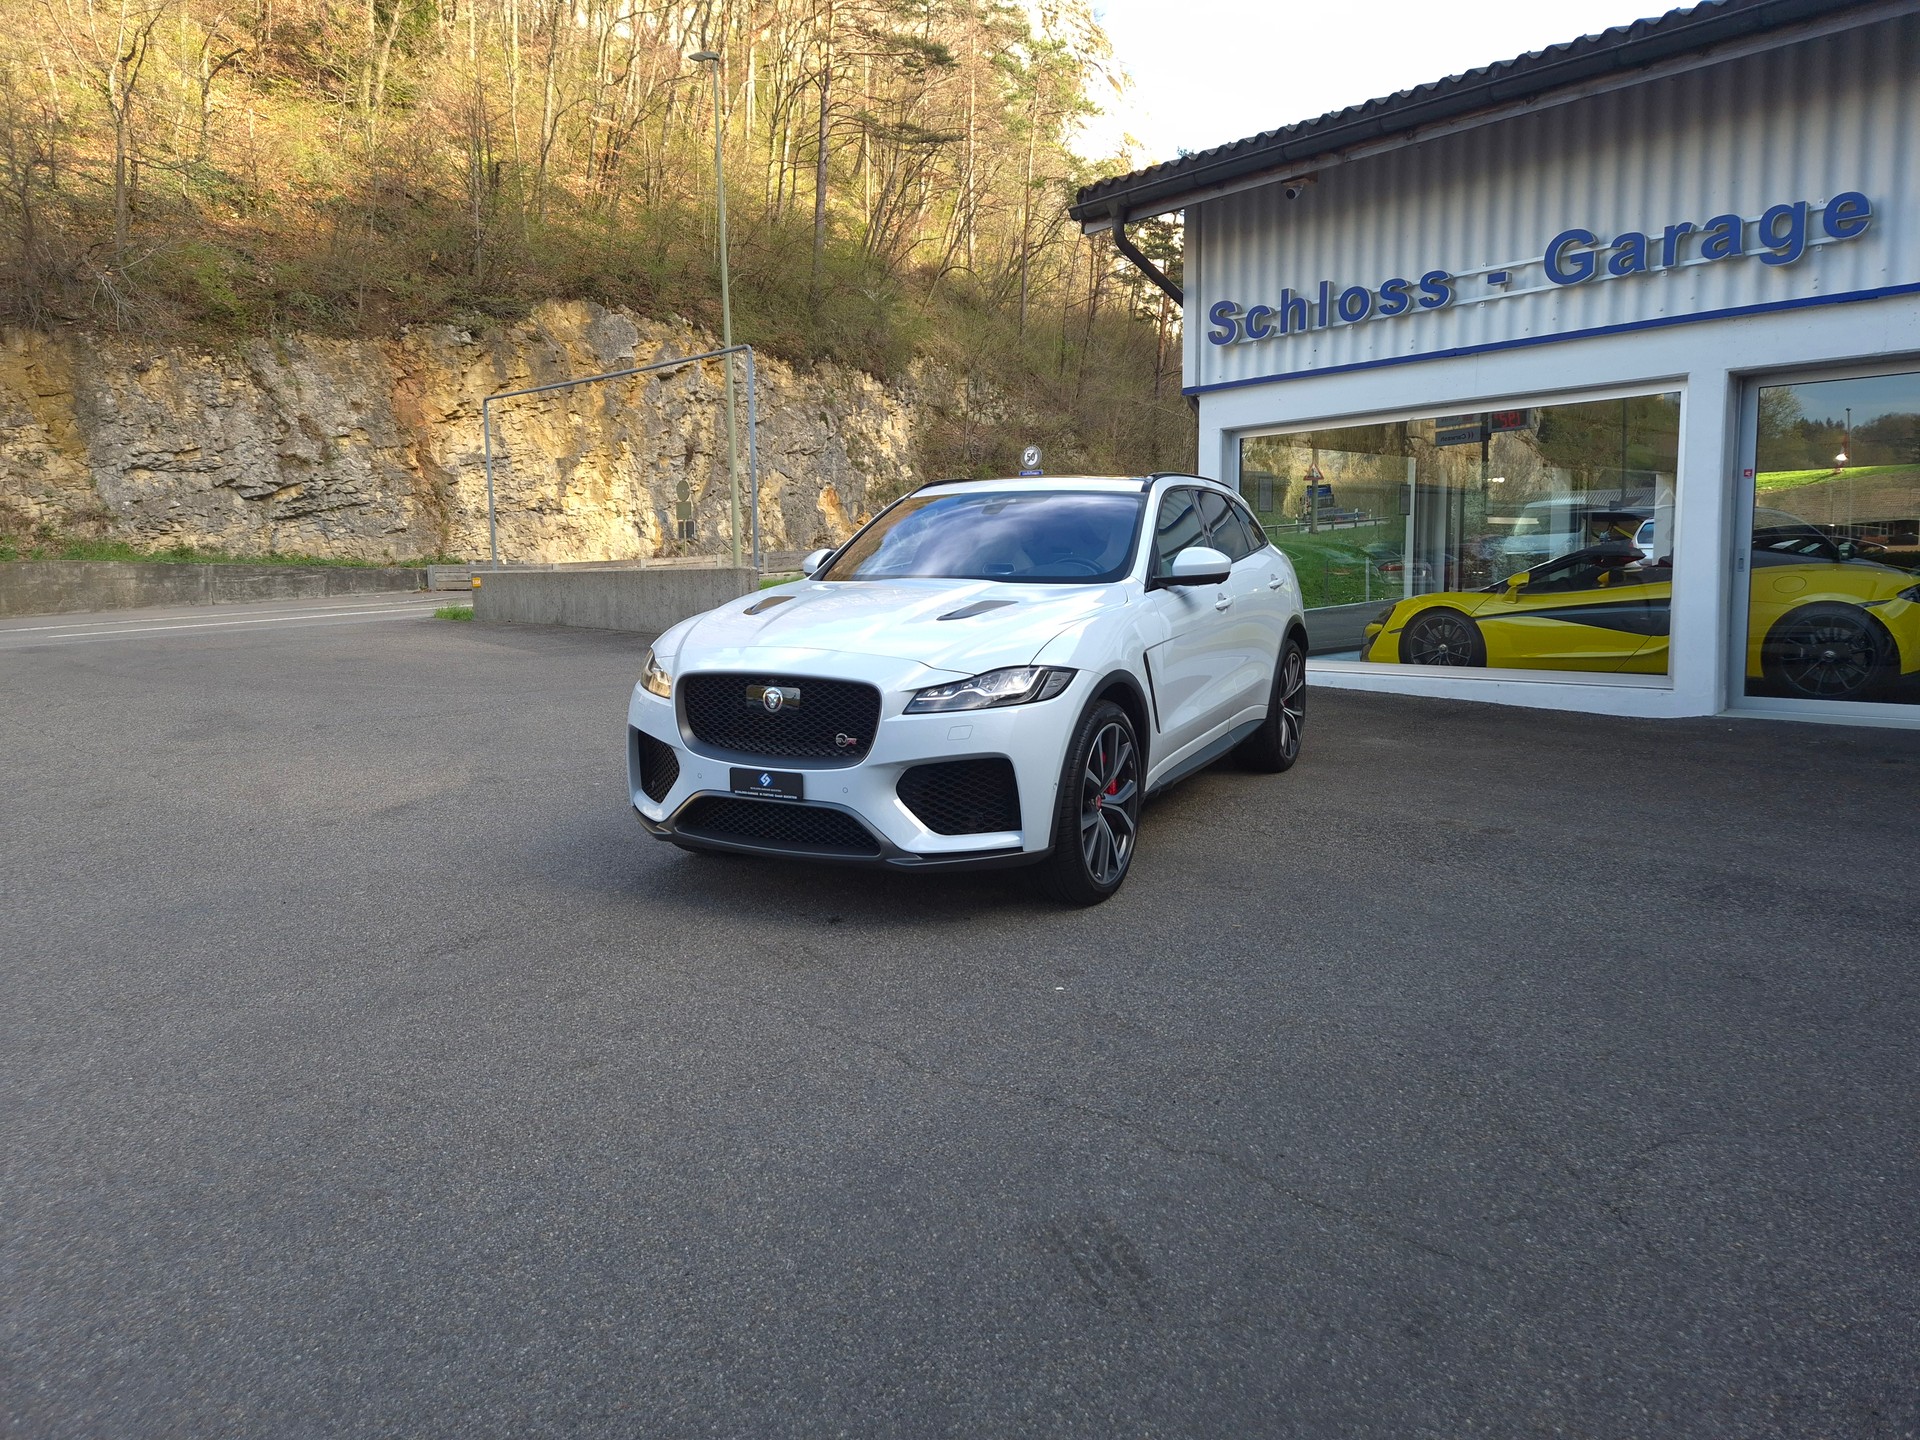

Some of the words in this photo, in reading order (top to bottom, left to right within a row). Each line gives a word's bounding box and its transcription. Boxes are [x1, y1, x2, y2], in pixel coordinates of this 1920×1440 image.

[1209, 270, 1453, 345] Schloss
[1543, 191, 1873, 285] Garage
[1026, 452, 1036, 462] 50
